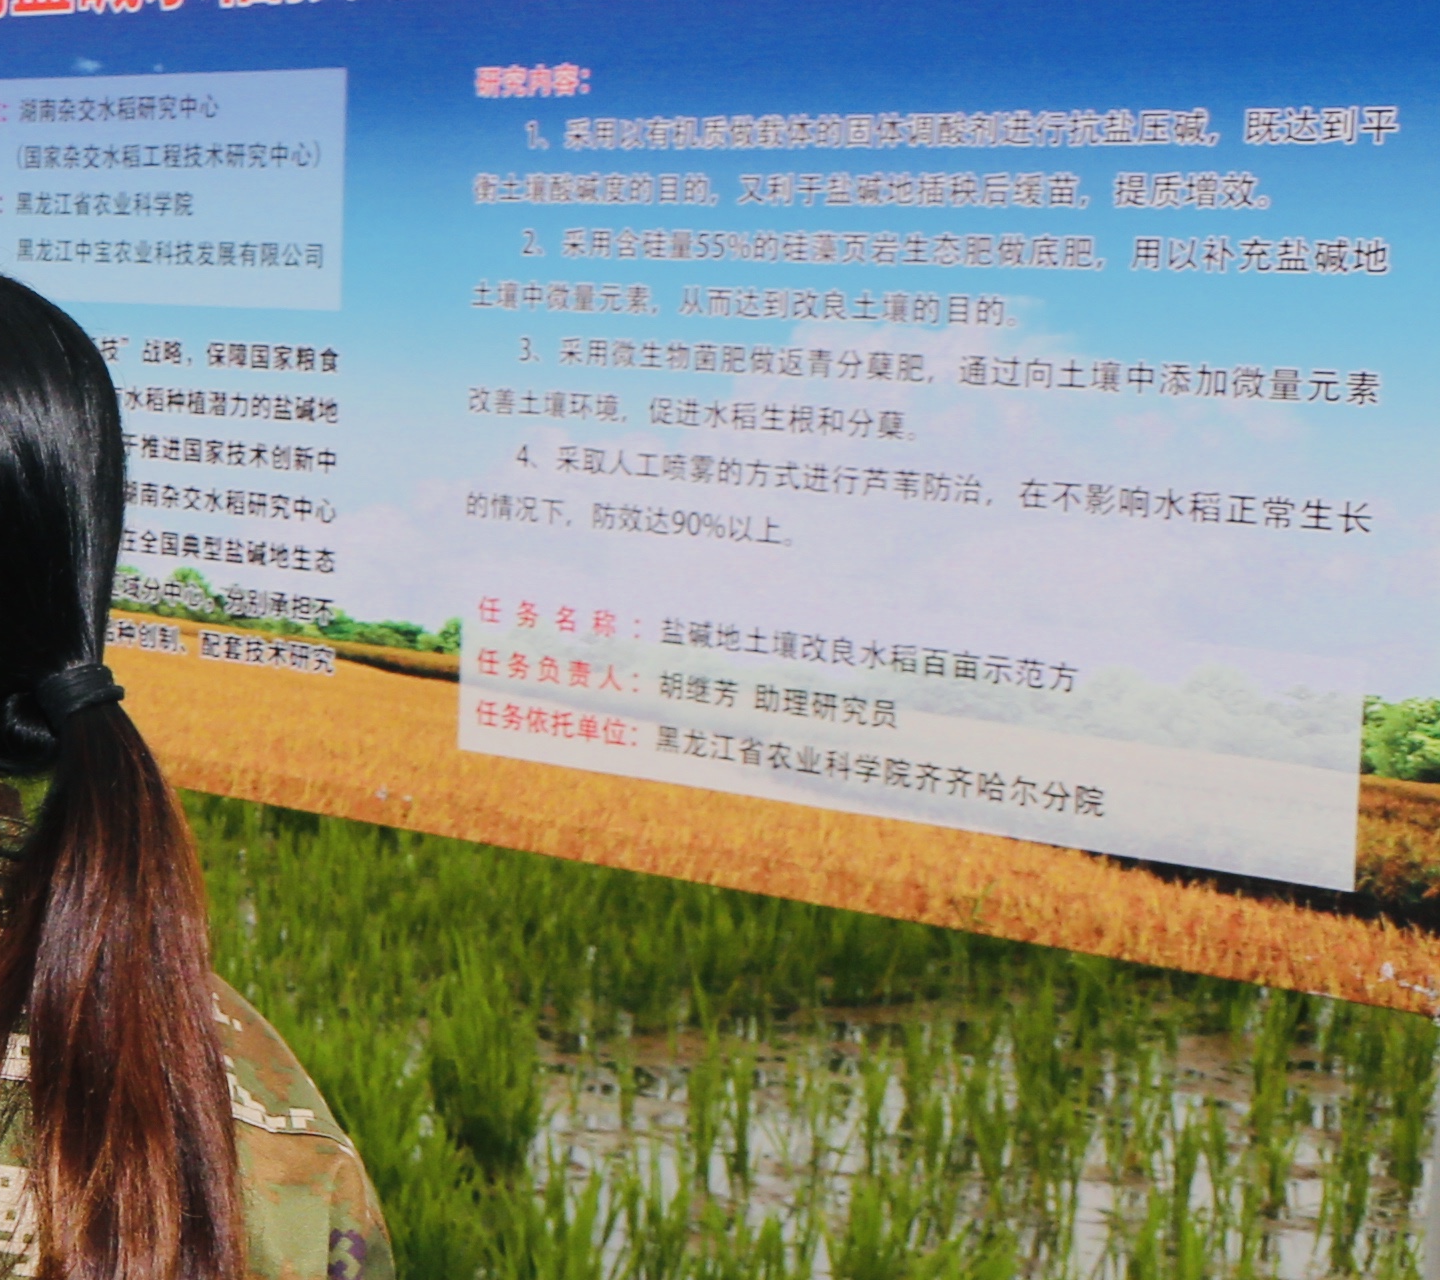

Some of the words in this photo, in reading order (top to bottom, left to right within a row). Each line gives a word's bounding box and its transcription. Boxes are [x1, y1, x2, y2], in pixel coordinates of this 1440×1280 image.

[475, 63, 591, 98] 研究内容：
[18, 93, 220, 124] 湖南杂交水稻研究中心
[15, 191, 194, 217] 黑龙江省农业科学院
[16, 238, 325, 269] 黑龙江中宝农业科技发展有限公司
[477, 596, 642, 641] 任务名称：
[660, 616, 1080, 695] 盐碱地土壤改良水稻百亩示范方
[477, 646, 640, 694] 任务负责人：
[659, 668, 738, 710] 胡继芳
[753, 684, 898, 729] 助理研究员
[475, 698, 639, 749] 任务依托单位：
[655, 725, 1106, 818] 黑龙江省农业科学院齐齐哈尔分院
